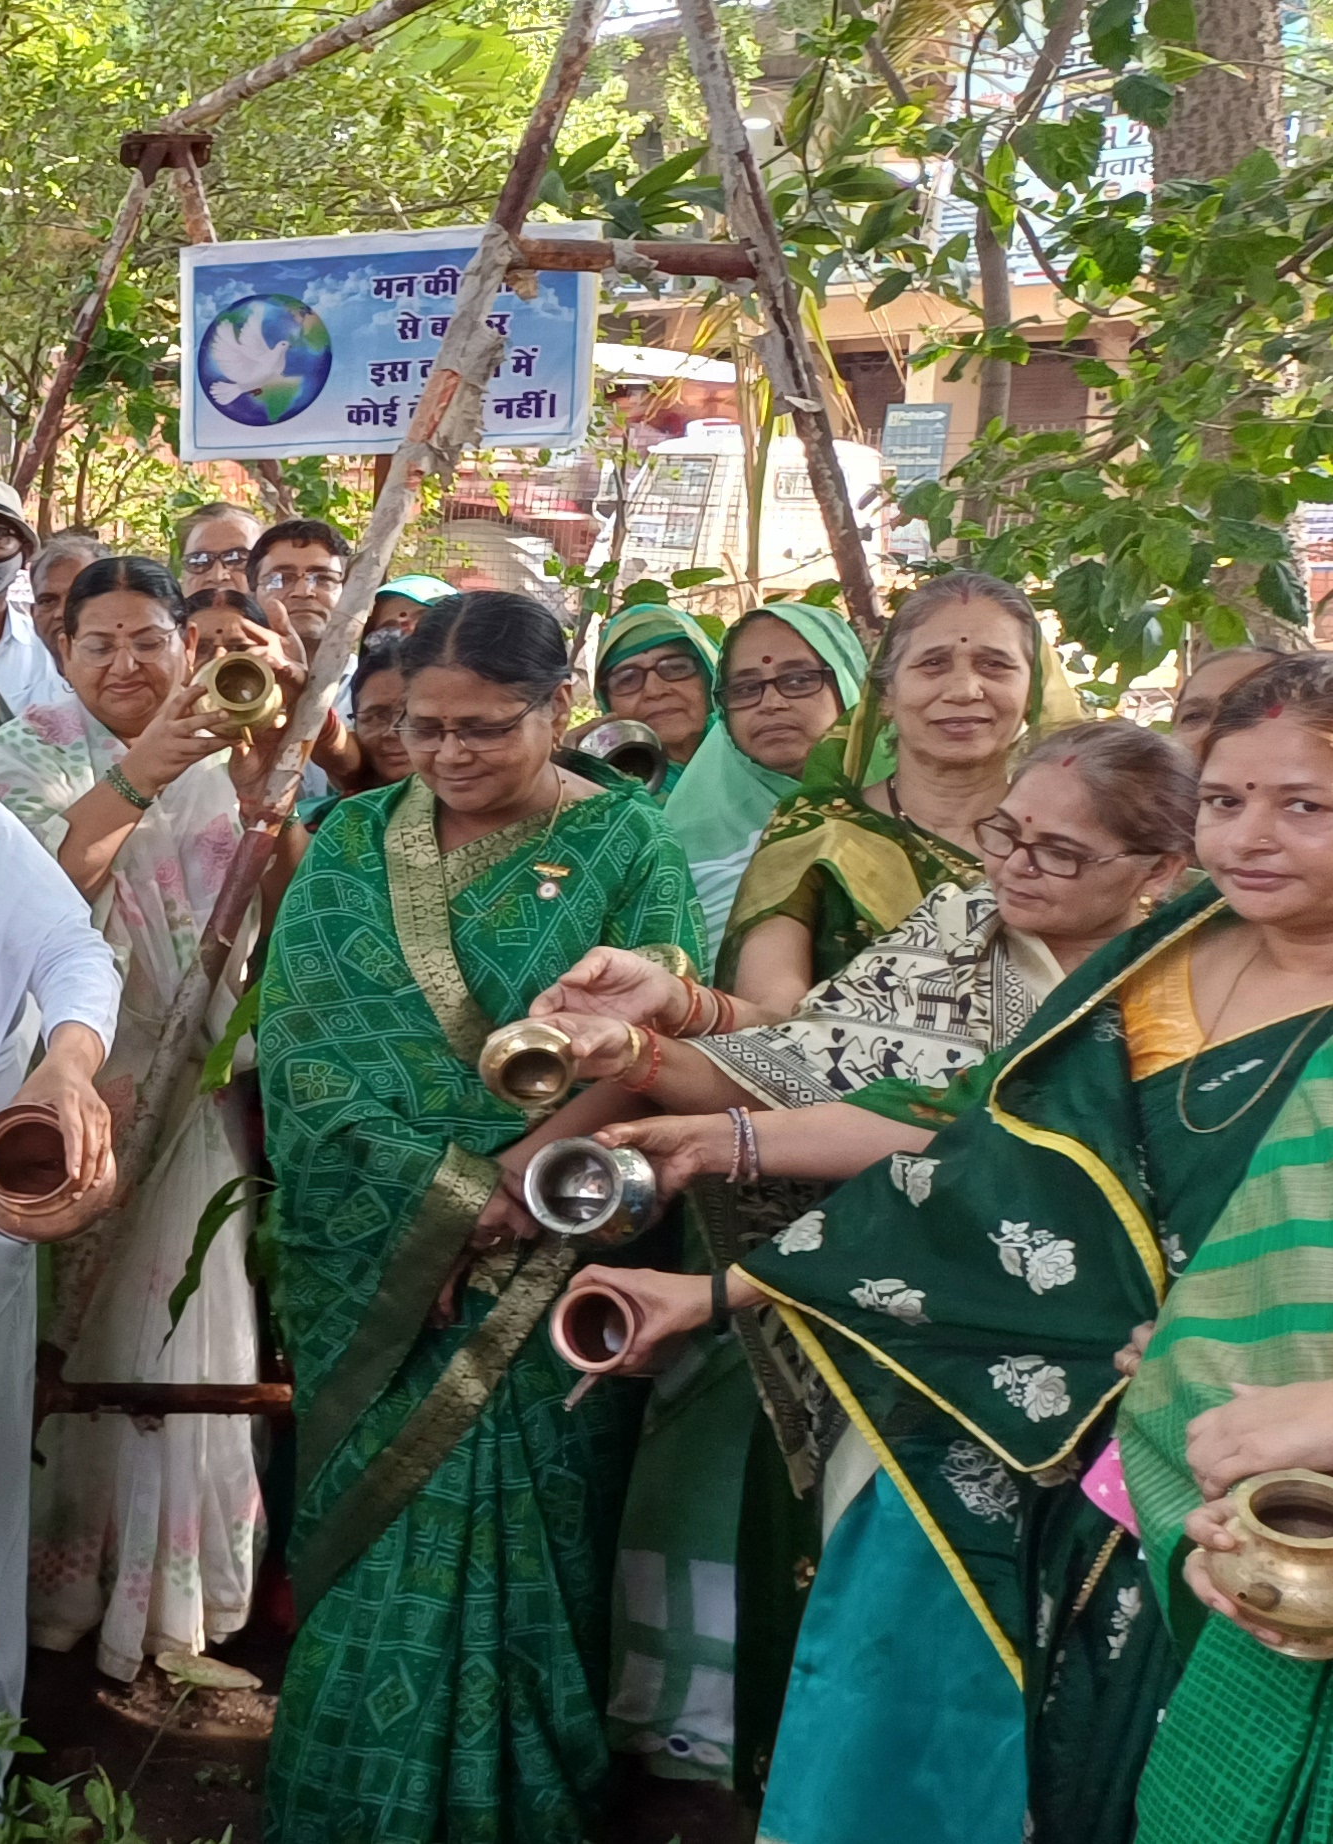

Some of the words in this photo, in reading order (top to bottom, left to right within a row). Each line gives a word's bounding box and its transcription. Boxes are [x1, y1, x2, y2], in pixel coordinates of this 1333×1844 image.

[373, 276, 417, 299] मन
[423, 267, 460, 296] की
[397, 311, 422, 340] से
[369, 360, 412, 387] इस
[511, 346, 539, 377] में
[345, 395, 401, 427] कोई
